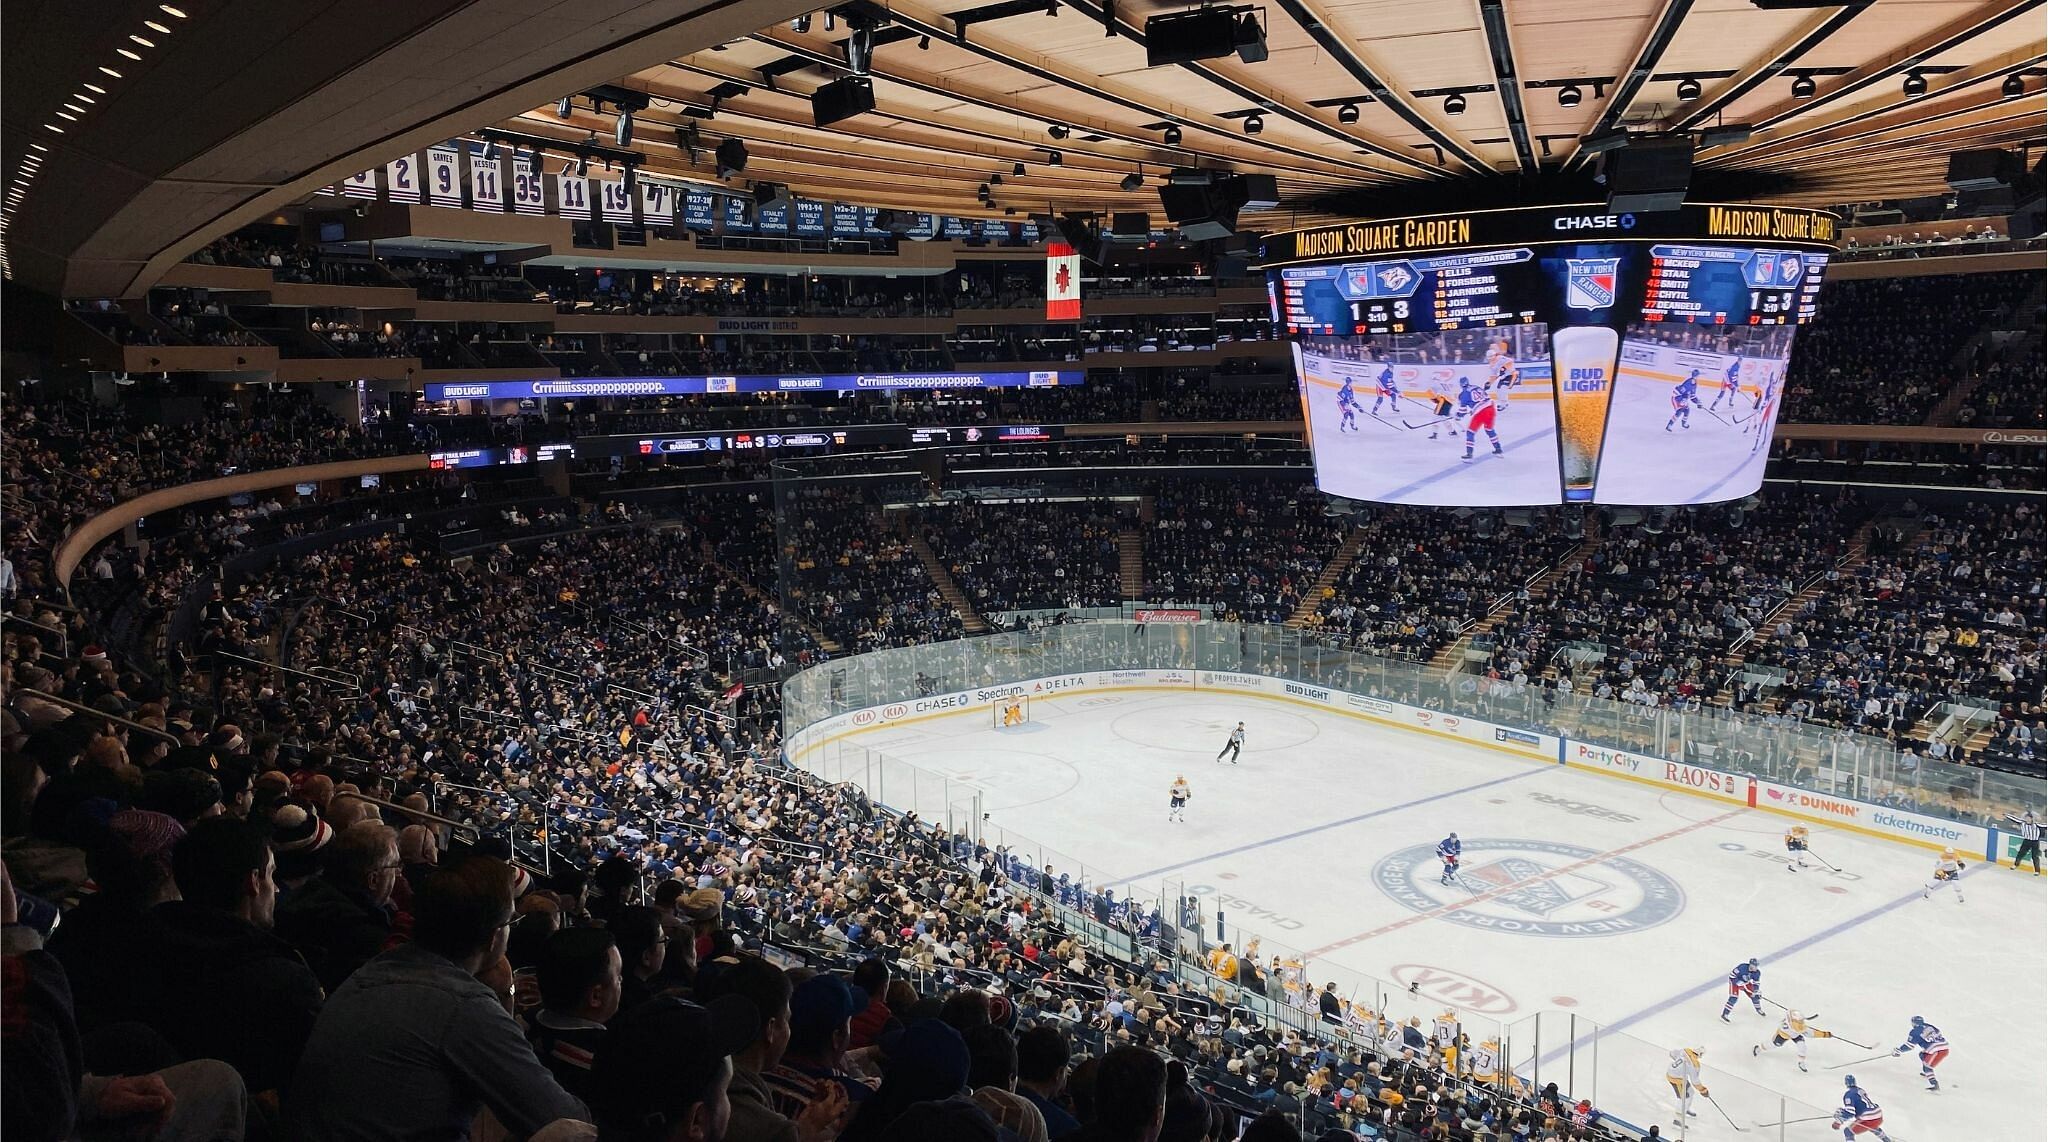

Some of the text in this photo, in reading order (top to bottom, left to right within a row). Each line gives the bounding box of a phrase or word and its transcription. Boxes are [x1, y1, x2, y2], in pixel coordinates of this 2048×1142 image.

[433, 153, 453, 163] GRAVES
[395, 159, 410, 189] 2
[516, 163, 529, 172] RICH
[437, 165, 451, 194] 9
[477, 171, 497, 200] 11
[515, 174, 541, 203] 35
[564, 180, 584, 207] 11
[604, 183, 628, 211] 19
[646, 187, 663, 213] 7
[688, 204, 709, 212] STANLEY
[797, 203, 823, 212] 1993-94
[686, 217, 713, 226] CHAMPIONS
[760, 222, 788, 230] CHAMPIONS
[1554, 215, 1618, 230] CHASE
[1709, 207, 1770, 236] MADISON
[1772, 209, 1810, 239] SQUARE
[1296, 218, 1470, 257] MADISON SQUARE GARDEN
[1429, 252, 1517, 267] NASHVILLE PREDATORS
[1445, 267, 1472, 278] ELLIS
[1572, 264, 1613, 274] NEW YORK
[1661, 269, 1690, 278] STAAL
[1445, 275, 1496, 287] FORSBERG
[1660, 280, 1689, 289] SMITH
[1447, 285, 1499, 297] JARNKROK
[1578, 276, 1612, 303] RANGERS
[1646, 290, 1690, 300] 72 CHYTIL
[1447, 298, 1469, 307] JOSI
[1645, 300, 1701, 310] 77 DEANGELO
[1750, 291, 1760, 311] 1
[1780, 292, 1792, 311] 3
[1350, 303, 1360, 321] 1
[1393, 300, 1409, 319] 3
[1448, 305, 1499, 317] JOHANSEN
[1368, 313, 1388, 322] 3:10
[1485, 319, 1497, 327] 12
[718, 321, 740, 330] BUD
[741, 321, 770, 330] LIGHT
[1392, 323, 1404, 332] 13
[1570, 368, 1604, 380] BUD
[780, 379, 821, 388] BUD LIGHT
[1563, 379, 1609, 392] LIGHT
[445, 386, 488, 397] BUD LIGHT
[726, 437, 733, 449] 1
[755, 436, 765, 448] 3
[785, 437, 823, 446] PREDATORS
[2003, 434, 2047, 443] LEXU
[669, 443, 699, 451] RANGERS
[1139, 610, 1196, 623] Budweiser
[1045, 677, 1085, 690] DELTA
[977, 686, 1021, 702] Spectrum
[1285, 684, 1329, 700] BUD LIGHT
[916, 696, 957, 713] CHASE
[1664, 762, 1721, 791] RAO'S
[1800, 795, 1860, 818] DUNKIN'
[1873, 811, 1964, 841] ticketmaster
[1746, 850, 1863, 881] CHSE
[1383, 857, 1437, 911] RANGERS
[1210, 892, 1305, 931] CHASE
[1449, 911, 1544, 934] YORK
[1561, 919, 1633, 935] NEW
[1414, 968, 1502, 1009] KIA
